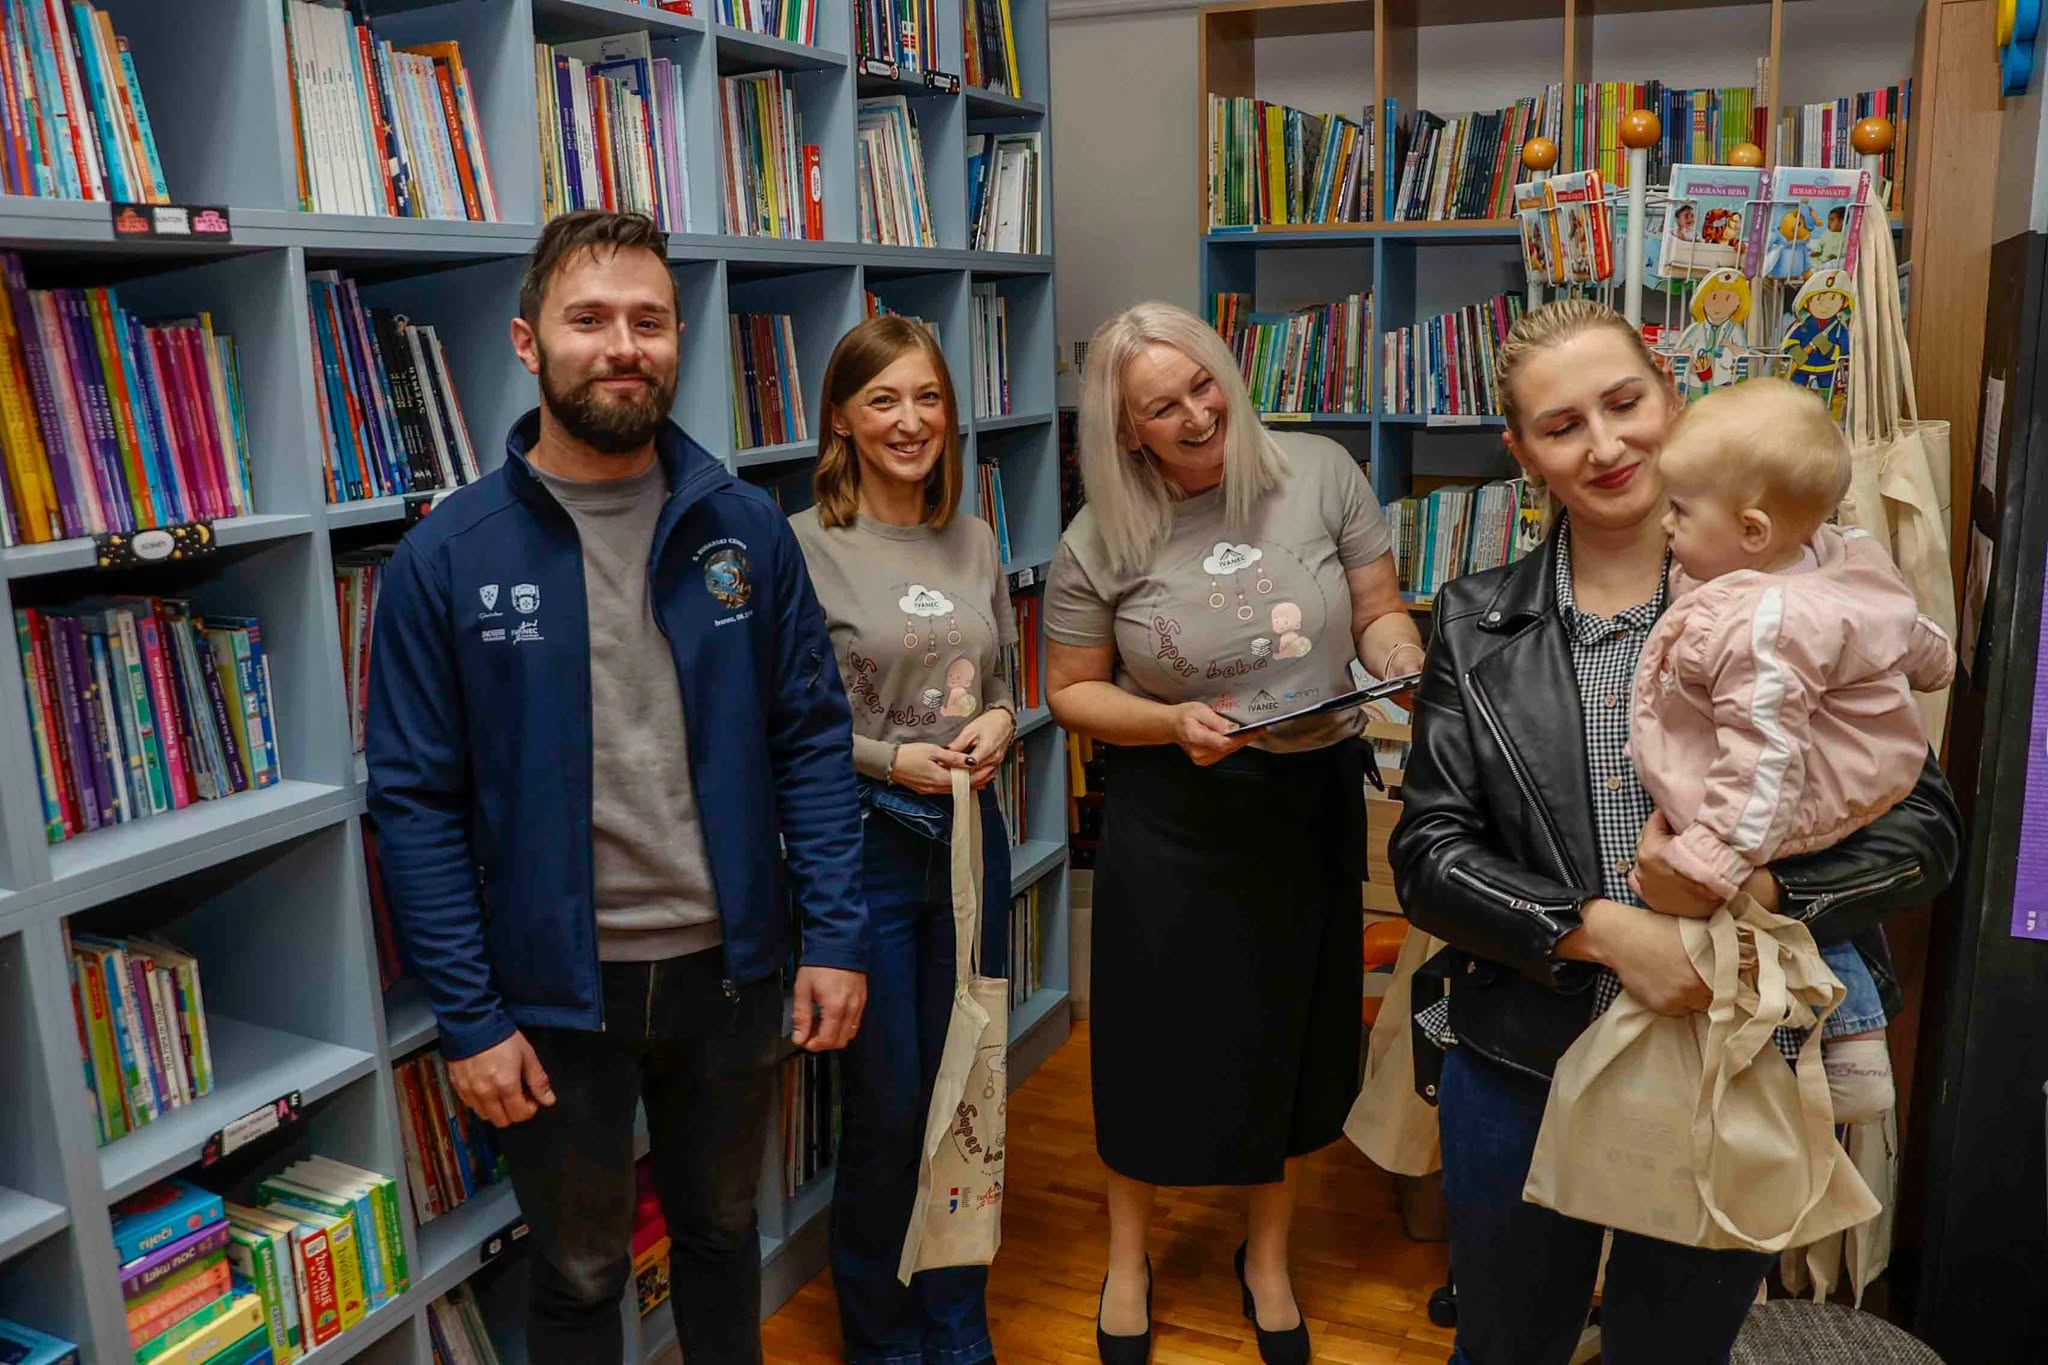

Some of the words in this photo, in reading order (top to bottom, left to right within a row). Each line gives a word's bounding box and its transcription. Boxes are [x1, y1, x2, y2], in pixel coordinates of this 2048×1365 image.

[1218, 555, 1247, 568] IVANEC
[1153, 615, 1200, 678] Super
[1207, 657, 1268, 680] beba
[850, 652, 884, 714] Super
[1248, 699, 1280, 713] IVANEC
[954, 1102, 983, 1155] Super
[983, 1145, 1003, 1164] be
[315, 1250, 333, 1307] ŽIVOTINJE
